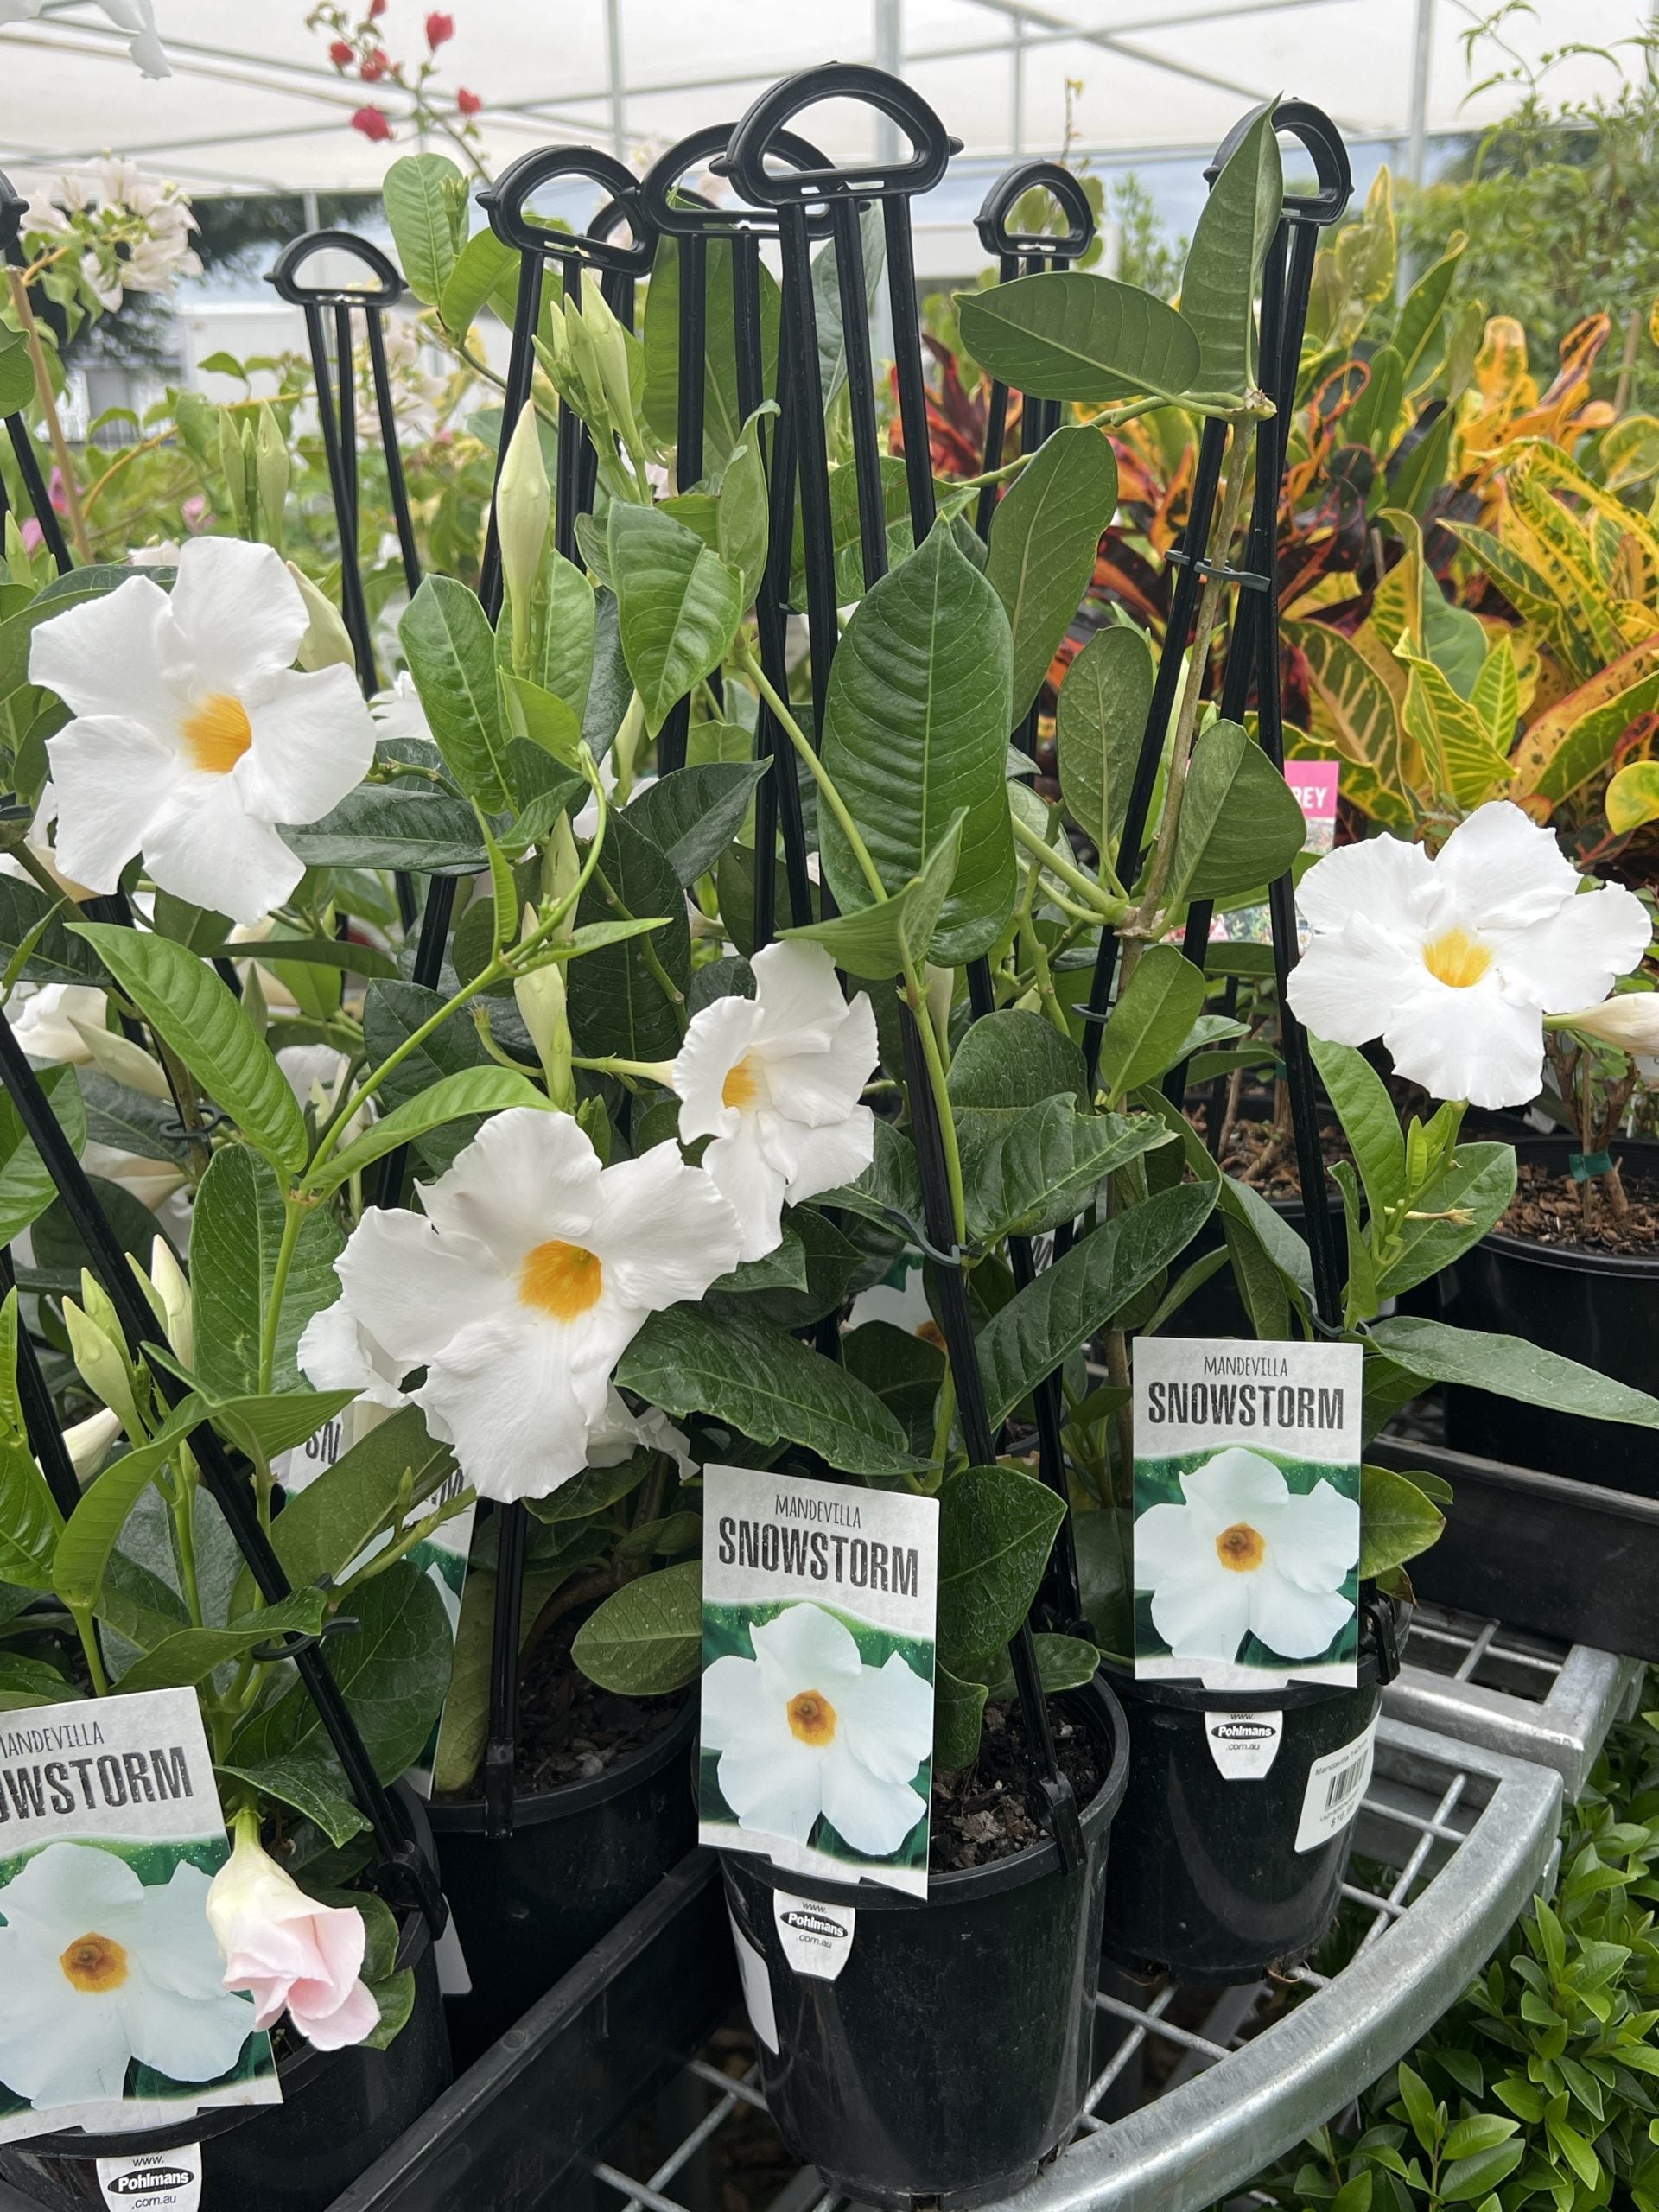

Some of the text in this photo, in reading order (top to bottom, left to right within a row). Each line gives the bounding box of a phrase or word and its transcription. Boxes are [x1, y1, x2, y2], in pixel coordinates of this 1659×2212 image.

[1204, 1357, 1288, 1377] MANDEVILLA
[1148, 1382, 1344, 1429] SNOWSTORM
[775, 1494, 861, 1529] MANDEVILLA
[719, 1516, 918, 1597] SNOWSTORM
[1218, 1726, 1272, 1738] Pohlmans
[803, 1902, 827, 1913] www.
[788, 1912, 844, 1936] Pohlmans
[132, 2156, 164, 2167] www.
[118, 2172, 189, 2192] Pohlmans
[131, 2196, 177, 2209] .com.au
